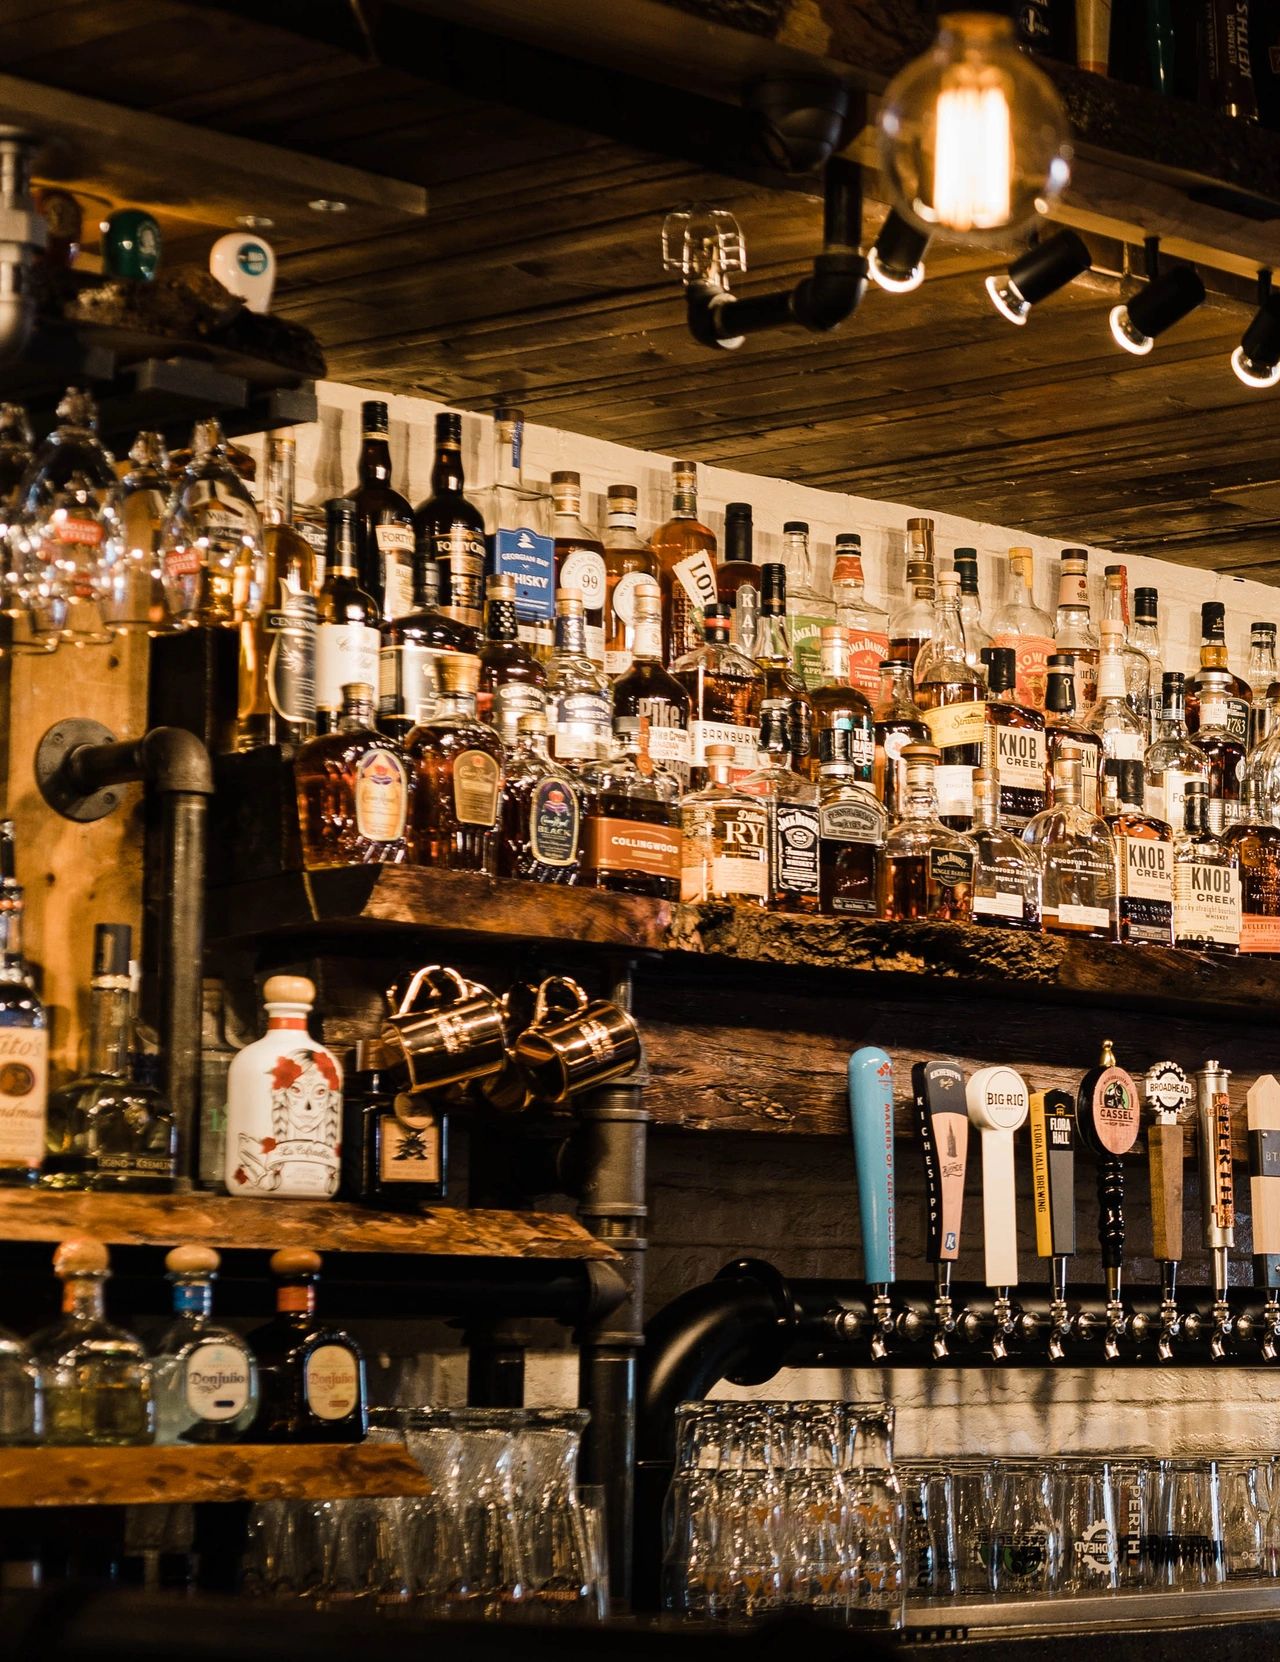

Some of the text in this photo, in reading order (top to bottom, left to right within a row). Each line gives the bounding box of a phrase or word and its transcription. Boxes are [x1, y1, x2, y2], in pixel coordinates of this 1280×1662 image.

[1227, 14, 1237, 65] ALEXANDER
[1235, 2, 1251, 79] KEITH'S
[501, 553, 535, 563] GEORGIAN
[501, 571, 549, 589] WHISKY
[582, 574, 599, 590] 99
[688, 560, 717, 606] LOT
[849, 640, 866, 656] JACK
[859, 680, 878, 688] FIRE
[639, 698, 684, 729] Pike
[1227, 718, 1246, 734] 1783
[701, 728, 758, 744] BARNBURN
[1000, 732, 1037, 759] KNOB
[1006, 757, 1043, 770] CREEK
[777, 814, 796, 832] JACK
[538, 826, 571, 837] BLACK
[611, 836, 678, 854] COLLINGWOOD
[1052, 857, 1087, 867] WOODFORD
[1129, 844, 1165, 870] KNOB
[981, 864, 1014, 875] WOODFORD
[1136, 868, 1172, 880] CREEK
[1191, 866, 1231, 894] KNOB
[1197, 892, 1236, 906] CREEK
[1195, 904, 1217, 915] straight
[1149, 1083, 1190, 1096] BROADHEAD
[987, 1092, 1024, 1107] BIG RIG
[1100, 1109, 1134, 1121] CASSEL
[884, 1103, 892, 1150] MAKERS
[1050, 1117, 1071, 1131] FLORA
[1052, 1130, 1070, 1144] HALL
[886, 1154, 893, 1169] OF
[917, 1096, 937, 1236] KICHESIPPI
[1033, 1123, 1046, 1213] FLORA HALL BREWING
[1130, 1485, 1141, 1555] PERTH
[998, 1535, 1047, 1548] CASSEL
